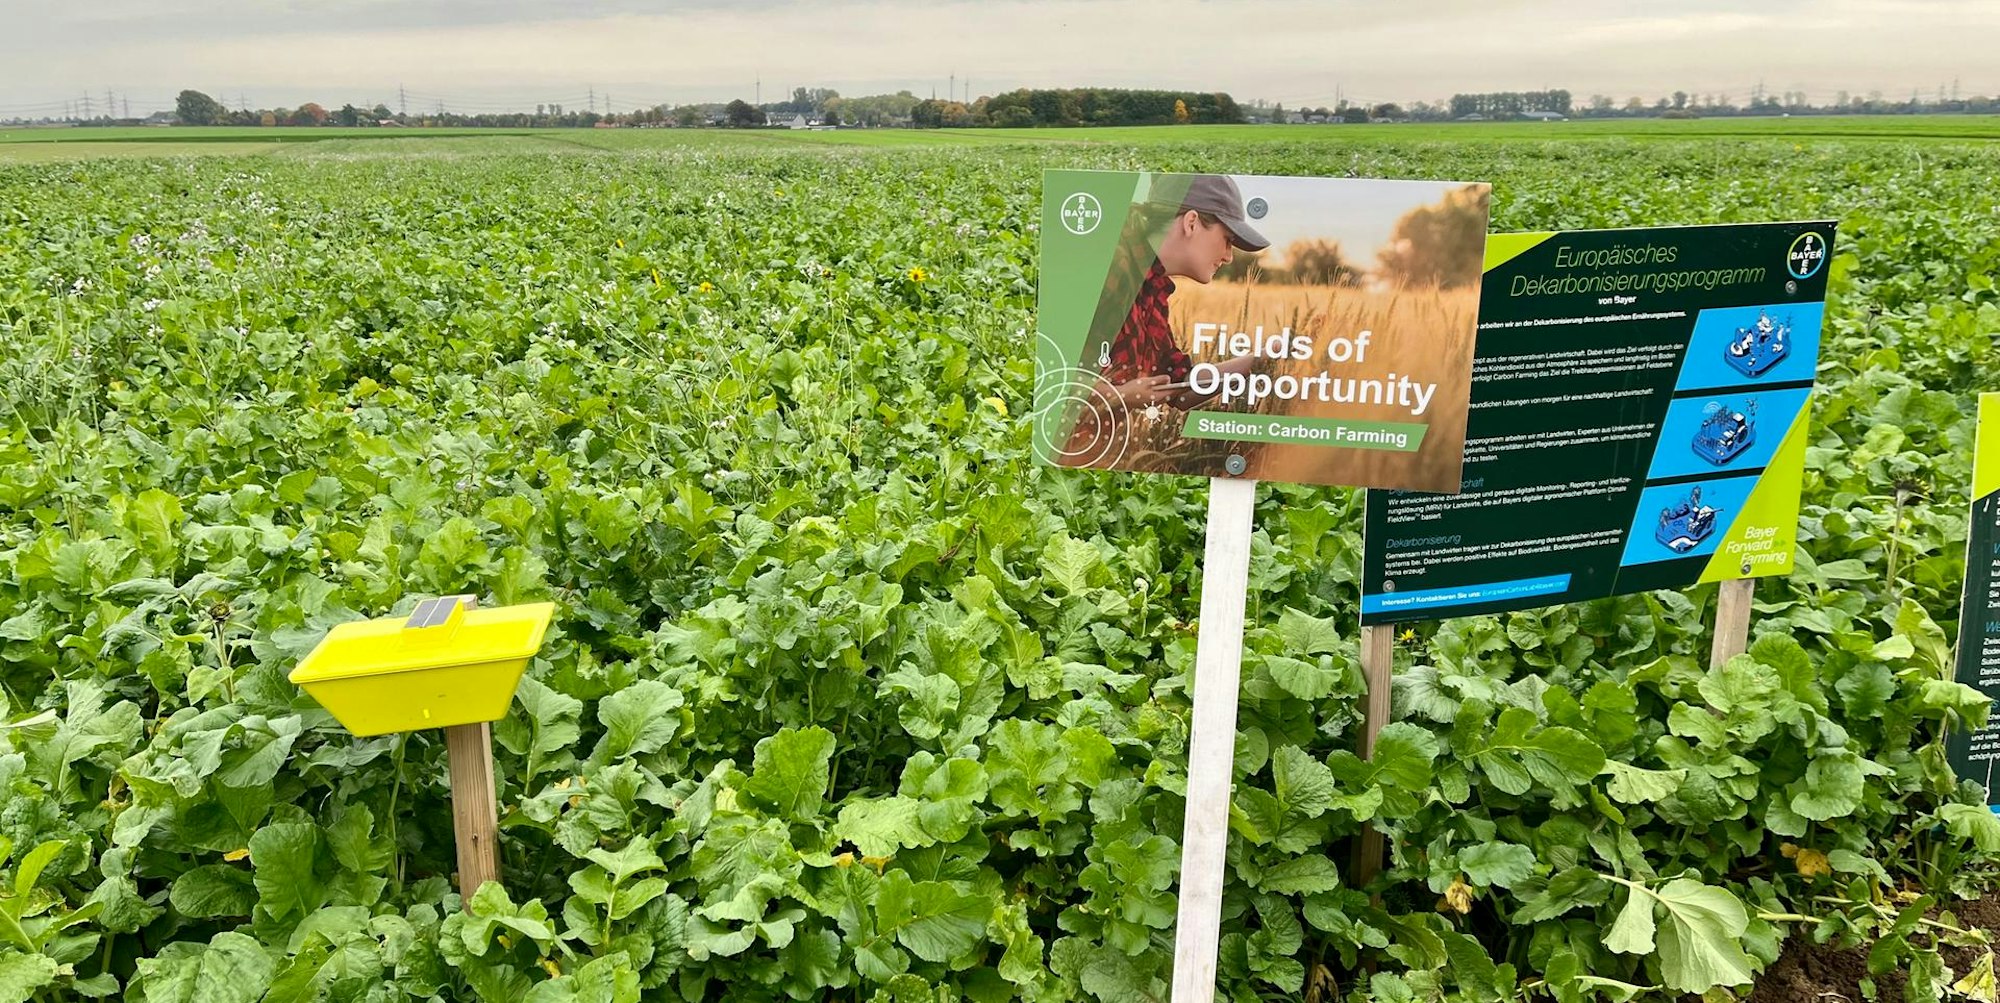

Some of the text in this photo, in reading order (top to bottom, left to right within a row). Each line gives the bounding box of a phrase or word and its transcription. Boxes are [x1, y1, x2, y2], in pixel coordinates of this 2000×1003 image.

[1064, 210, 1098, 218] BAYER
[1555, 243, 1678, 270] Europäisches
[1790, 248, 1822, 260] BAYER
[1510, 266, 1766, 297] Dekarbonisierungsprogramm
[1614, 295, 1637, 305] Bayer
[1192, 322, 1372, 363] Fields of
[1189, 362, 1437, 416] Opportunity
[1502, 399, 1530, 407] Lösungen
[1198, 418, 1408, 448] Station: Carbon Farming
[1744, 526, 1779, 540] Bayer
[1386, 534, 1462, 549] Dekarbonisierung
[1726, 538, 1773, 554] Forward
[1740, 550, 1787, 566] Farming
